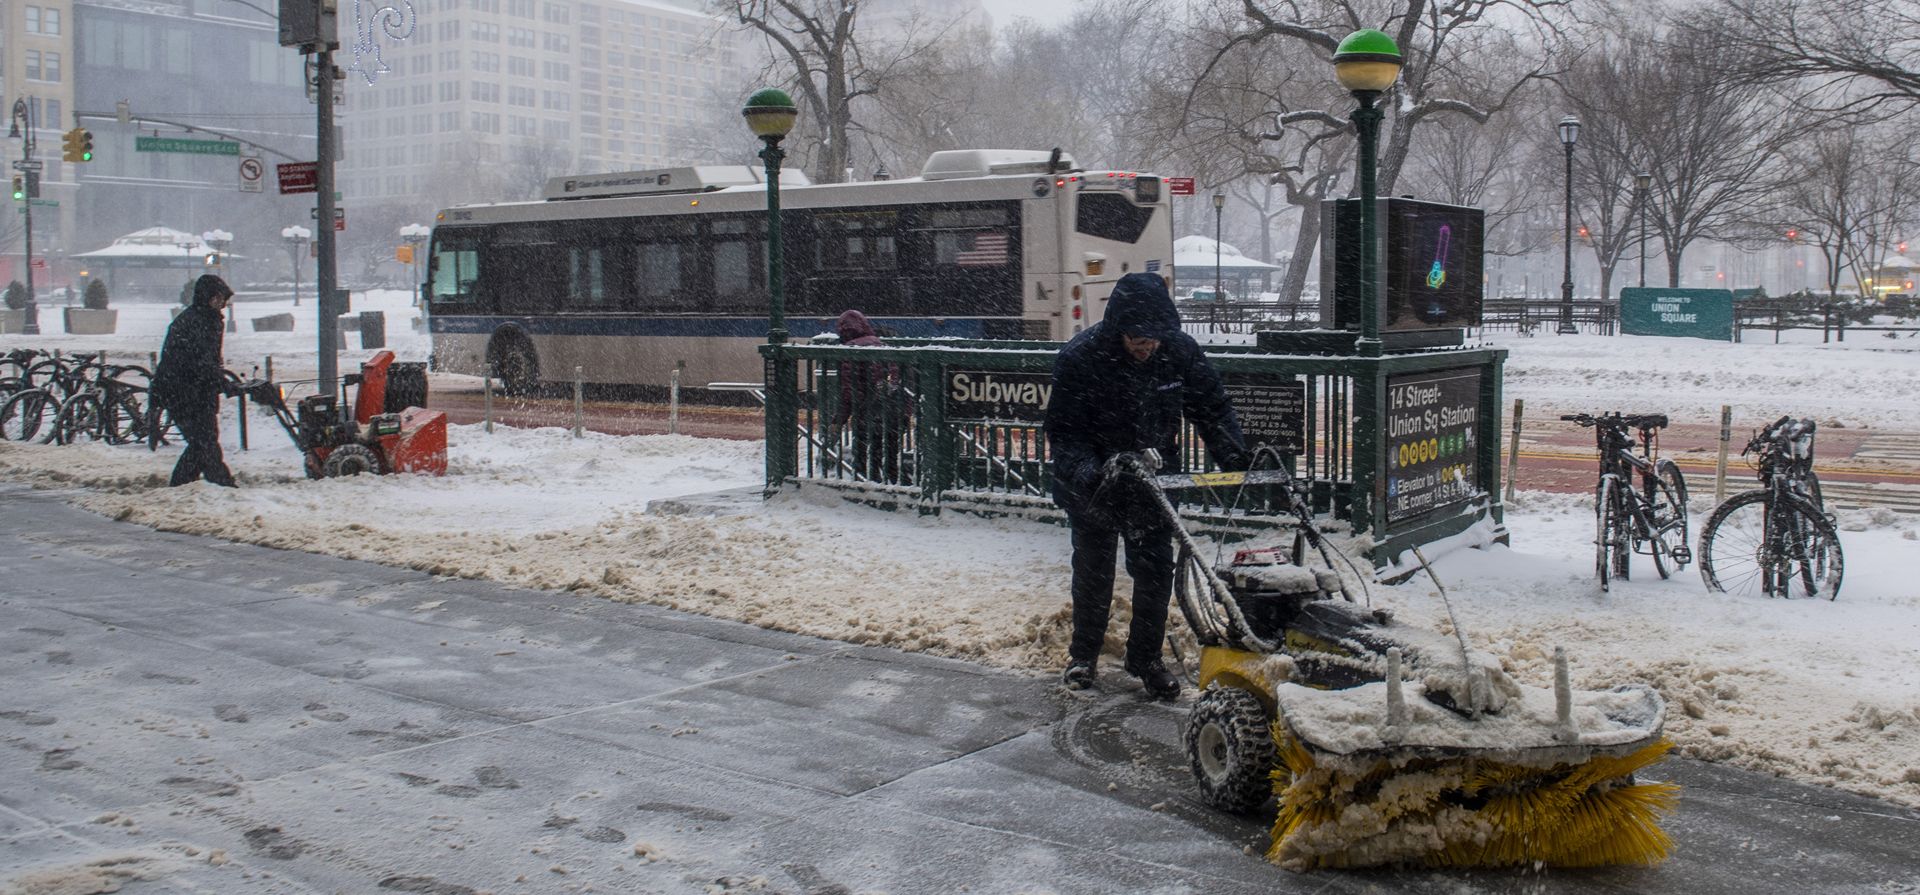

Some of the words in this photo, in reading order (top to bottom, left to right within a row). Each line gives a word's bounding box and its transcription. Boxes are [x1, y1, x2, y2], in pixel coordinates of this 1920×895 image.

[175, 142, 214, 152] Square
[1651, 303, 1680, 312] UNION
[1661, 313, 1697, 323] SQUARE
[952, 373, 1053, 410] Subway
[1390, 387, 1403, 410] 14
[1246, 413, 1269, 421] Property
[1389, 413, 1421, 438] Union
[1424, 409, 1439, 435] Sq
[1440, 403, 1475, 428] Station
[1397, 476, 1426, 495] Elevator
[1427, 473, 1434, 487] to
[1466, 463, 1473, 477] at
[1397, 494, 1409, 511] NE
[1410, 492, 1433, 508] corner
[1434, 486, 1441, 502] 14
[1442, 484, 1450, 499] St
